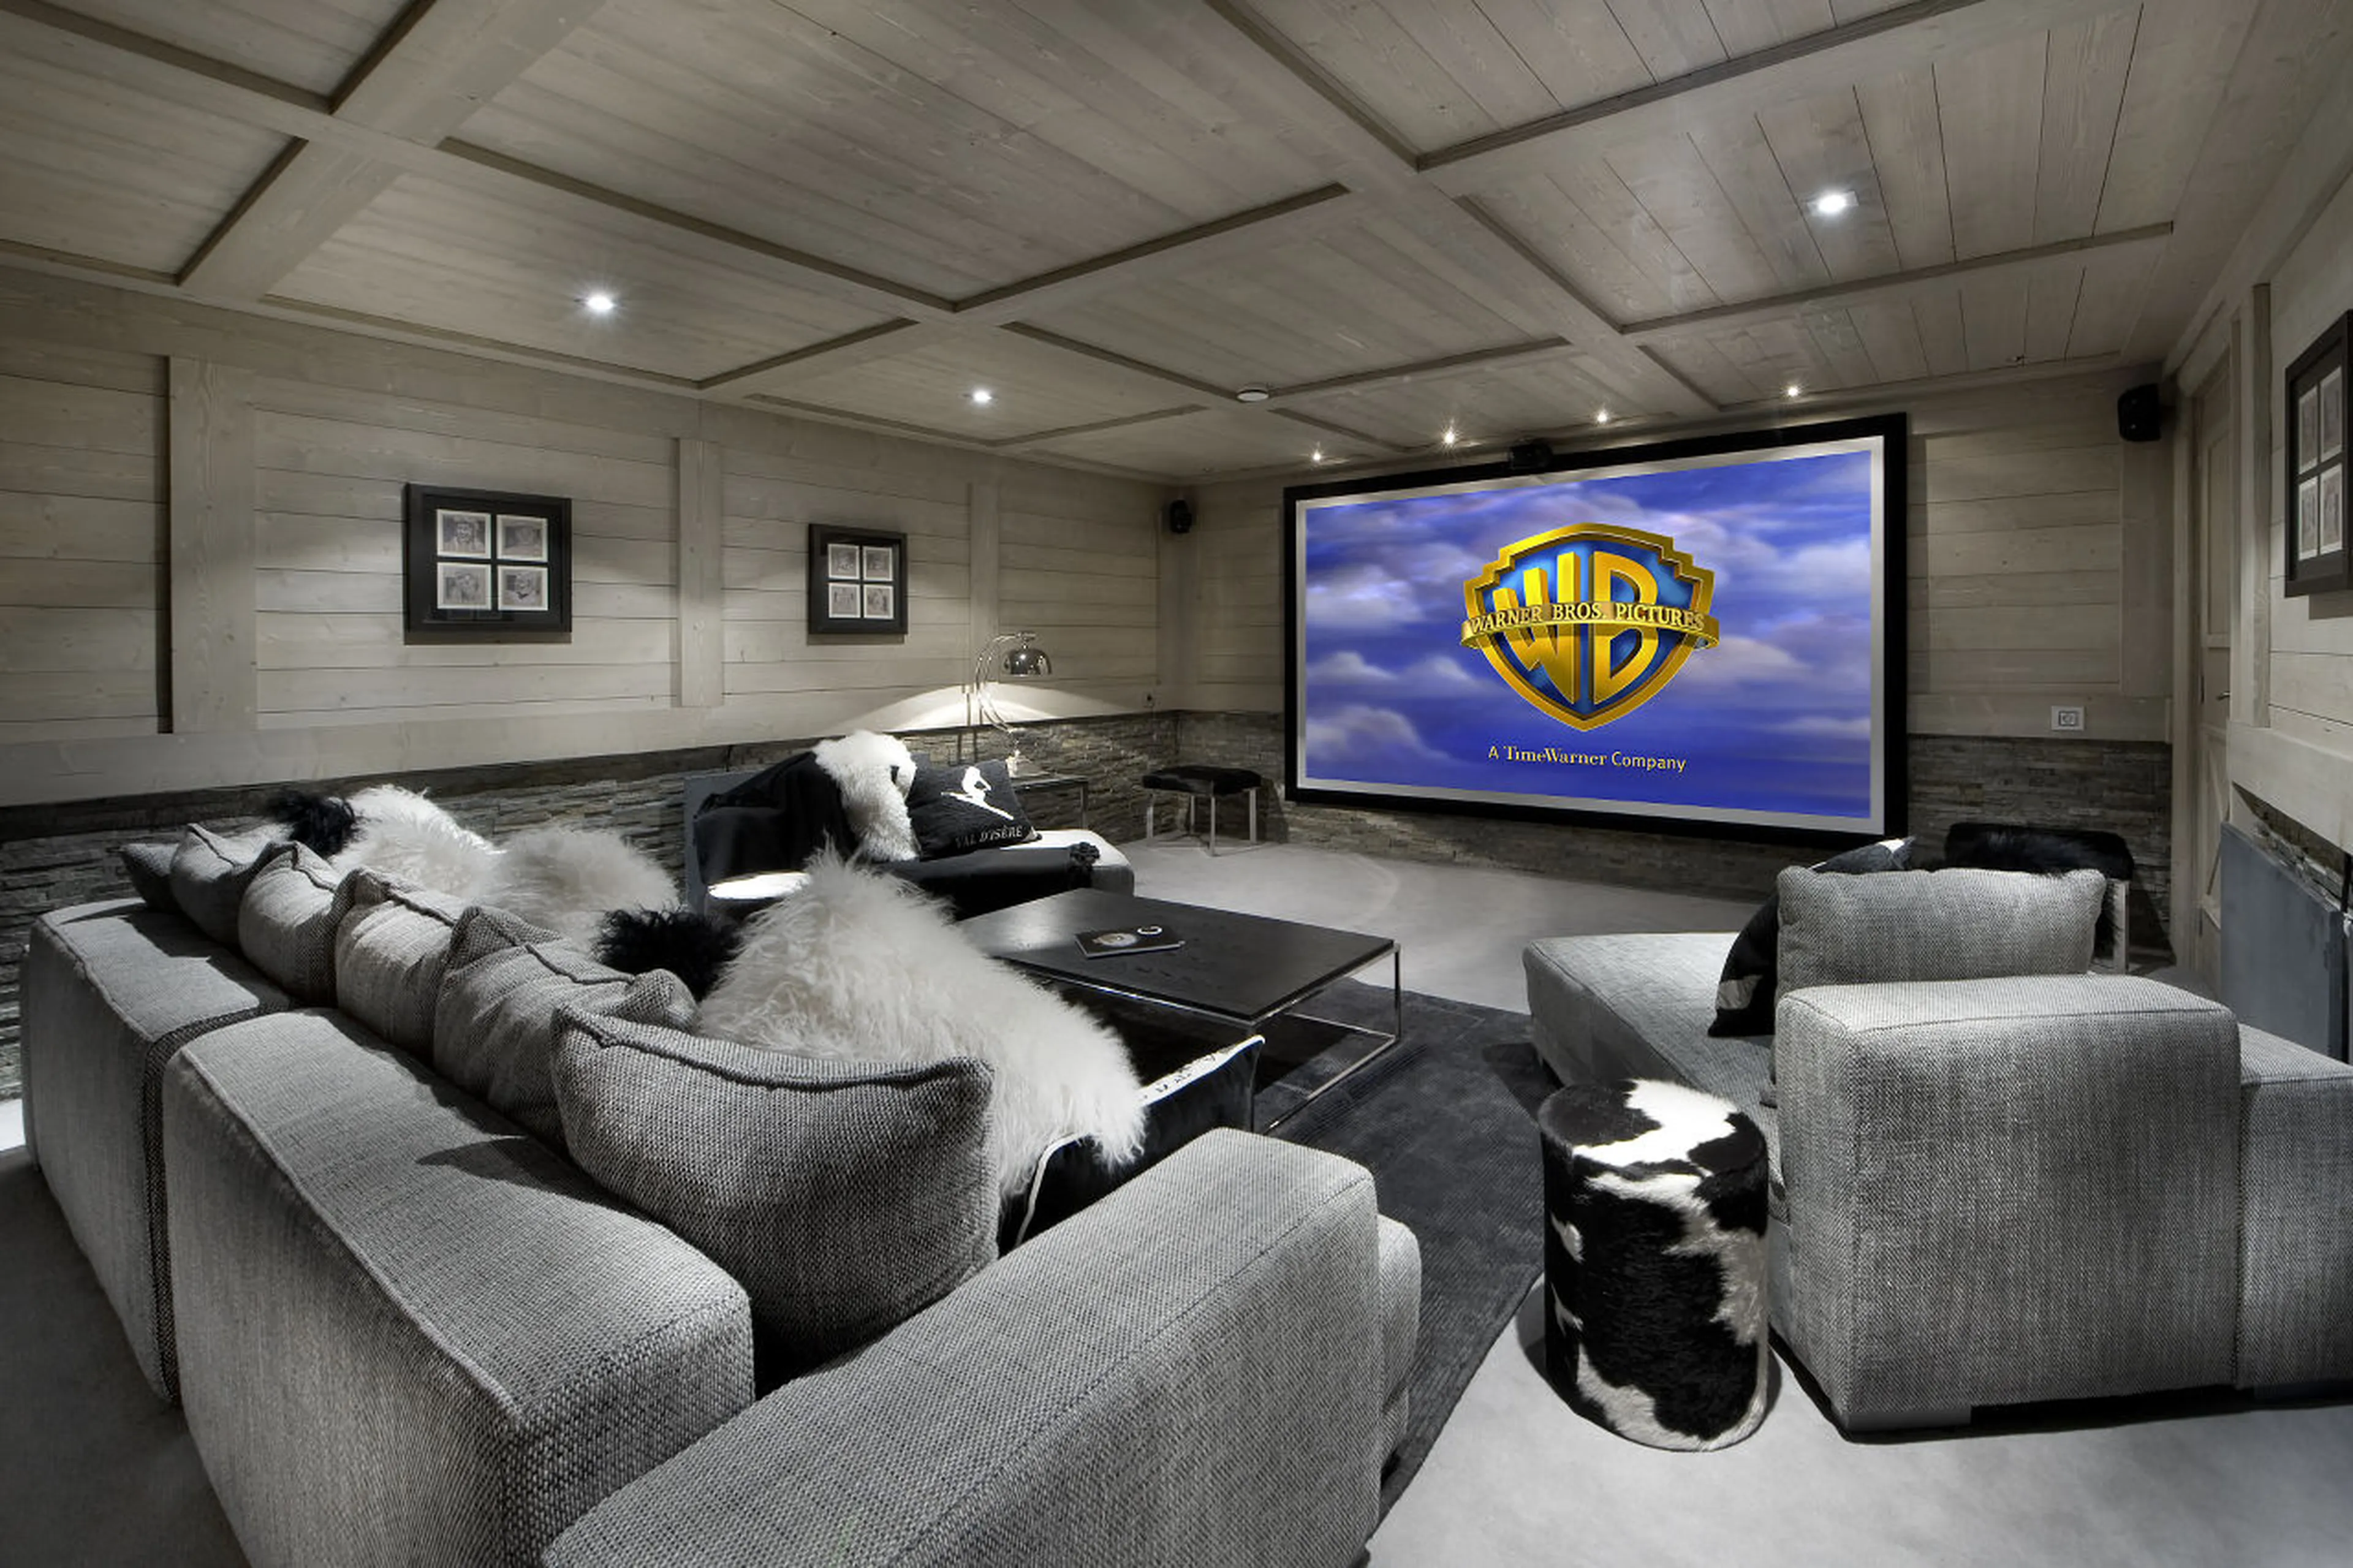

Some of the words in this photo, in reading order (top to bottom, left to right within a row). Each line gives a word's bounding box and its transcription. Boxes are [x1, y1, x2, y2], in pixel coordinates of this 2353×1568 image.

[1471, 605, 1544, 634] WARNER
[1552, 602, 1607, 620] BROS.
[1615, 602, 1705, 631] PICTURES
[1488, 746, 1499, 760] A
[1503, 746, 1608, 766] TimeWarner
[1611, 751, 1686, 773] Company
